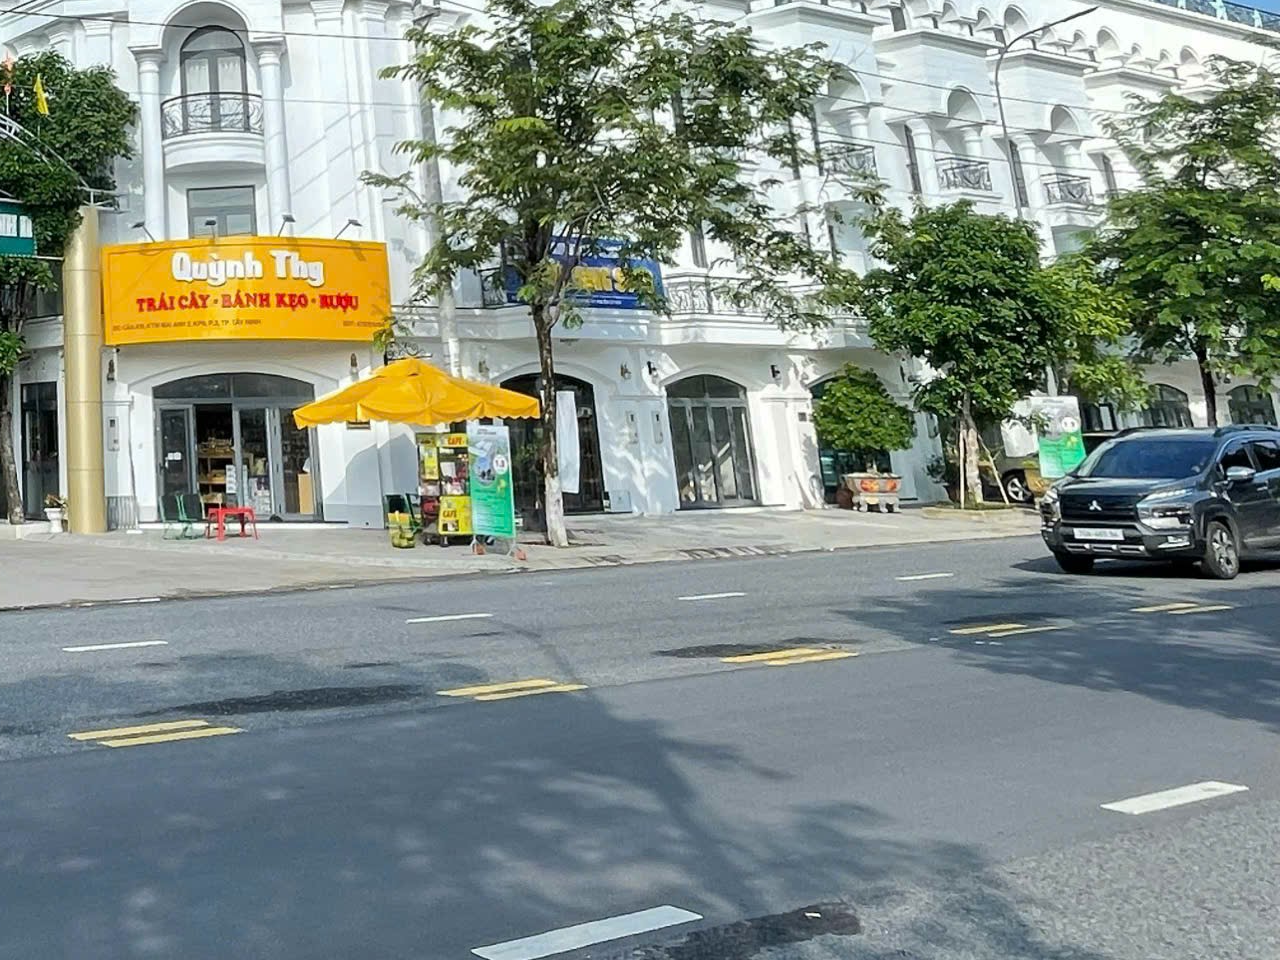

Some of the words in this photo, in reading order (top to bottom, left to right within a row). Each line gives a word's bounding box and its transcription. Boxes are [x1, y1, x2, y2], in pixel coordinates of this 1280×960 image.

[172, 251, 263, 286] Quỳnh
[136, 292, 175, 312] TRÁI
[178, 290, 210, 310] CÂY
[221, 289, 271, 308] BÁNH
[275, 292, 309, 311] KẸO
[319, 292, 359, 313] RƯỢU
